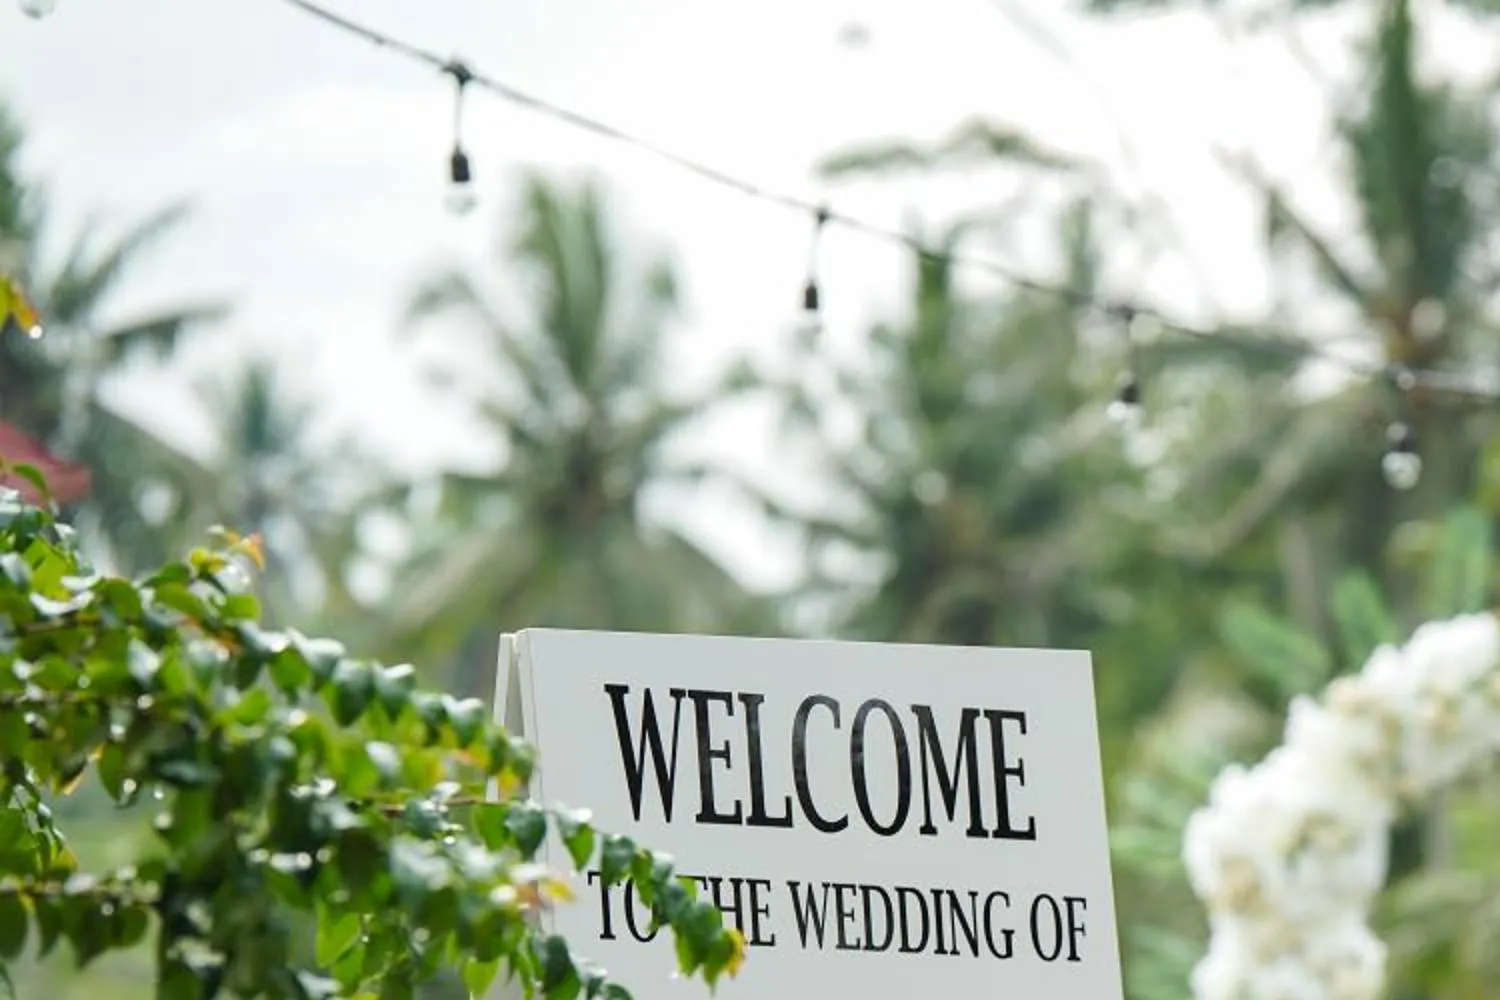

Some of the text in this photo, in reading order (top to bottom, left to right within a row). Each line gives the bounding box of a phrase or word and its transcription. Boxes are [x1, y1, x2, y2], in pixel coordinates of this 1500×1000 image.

[603, 683, 1037, 841] WELCOME
[786, 880, 1015, 960] WEDDING
[1029, 893, 1087, 962] OF
